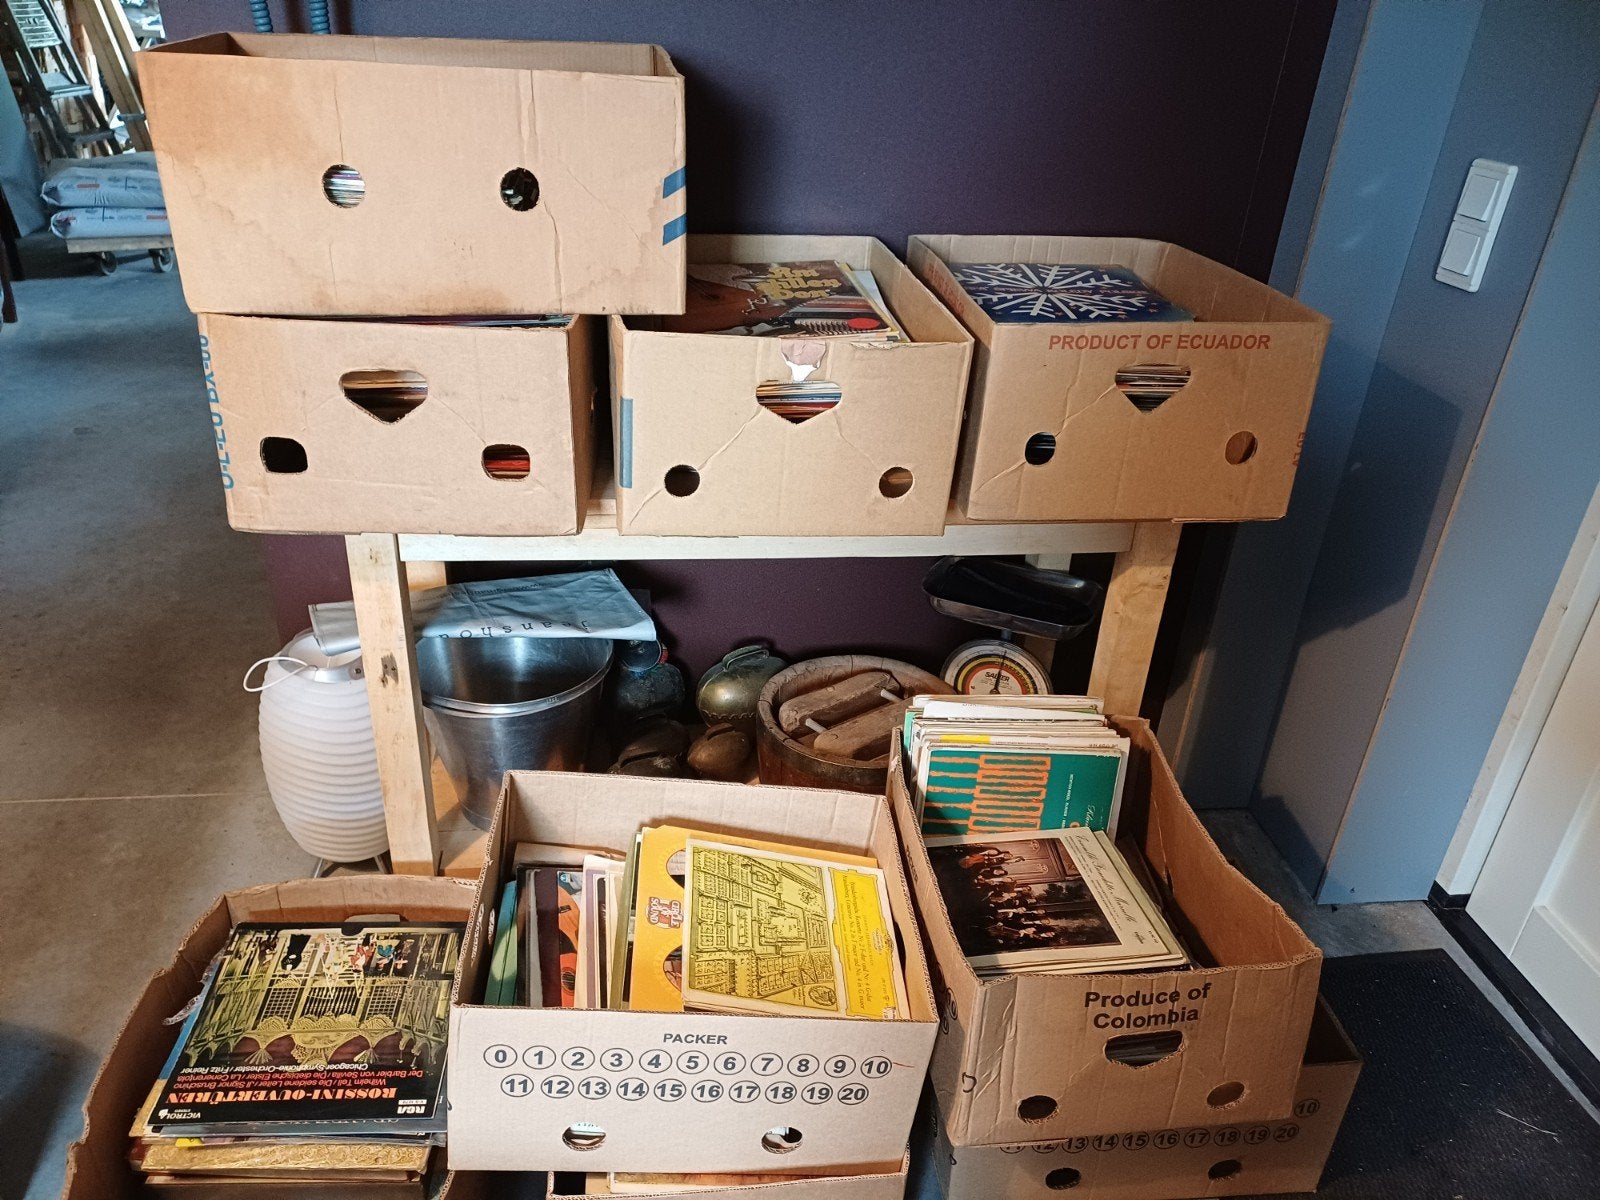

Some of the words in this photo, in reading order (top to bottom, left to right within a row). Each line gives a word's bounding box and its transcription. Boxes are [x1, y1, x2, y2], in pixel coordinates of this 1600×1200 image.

[1049, 334, 1141, 350] PRODUCT
[1146, 334, 1173, 350] OF
[1177, 334, 1271, 350] ECUADOR
[650, 897, 660, 924] SOUND
[1084, 990, 1181, 1008] Produce
[1187, 983, 1212, 999] of
[1093, 1007, 1199, 1029] Colombia
[663, 1033, 728, 1045] PACKER
[234, 1064, 326, 1072] Symphonie-Orchester
[864, 1060, 889, 1075] 10
[272, 1072, 312, 1080] diebische
[332, 1071, 359, 1079] Sevilla
[375, 1070, 407, 1078] Barbier
[407, 1070, 424, 1078] Der
[166, 1087, 397, 1105] ROSSINI-OUVERTÜREN
[505, 1079, 528, 1093] 11
[543, 1080, 570, 1094] 12
[581, 1081, 607, 1096] 13
[619, 1082, 645, 1097] 14
[656, 1083, 683, 1098] 15
[696, 1085, 721, 1098] 16
[733, 1085, 758, 1099] 17
[770, 1086, 794, 1099] 18
[806, 1087, 831, 1100] 19
[840, 1088, 866, 1101] 20
[397, 1106, 426, 1114] RCA
[1299, 1103, 1317, 1115] 10
[160, 1111, 201, 1120] VICTROLA
[1067, 1138, 1086, 1149] 13
[1096, 1135, 1115, 1148] 14
[1125, 1135, 1147, 1147] 15
[1158, 1133, 1177, 1145] 16
[1188, 1132, 1208, 1144] 17
[1218, 1131, 1237, 1142] 18
[1248, 1130, 1268, 1141] 19
[1277, 1127, 1296, 1139] 20
